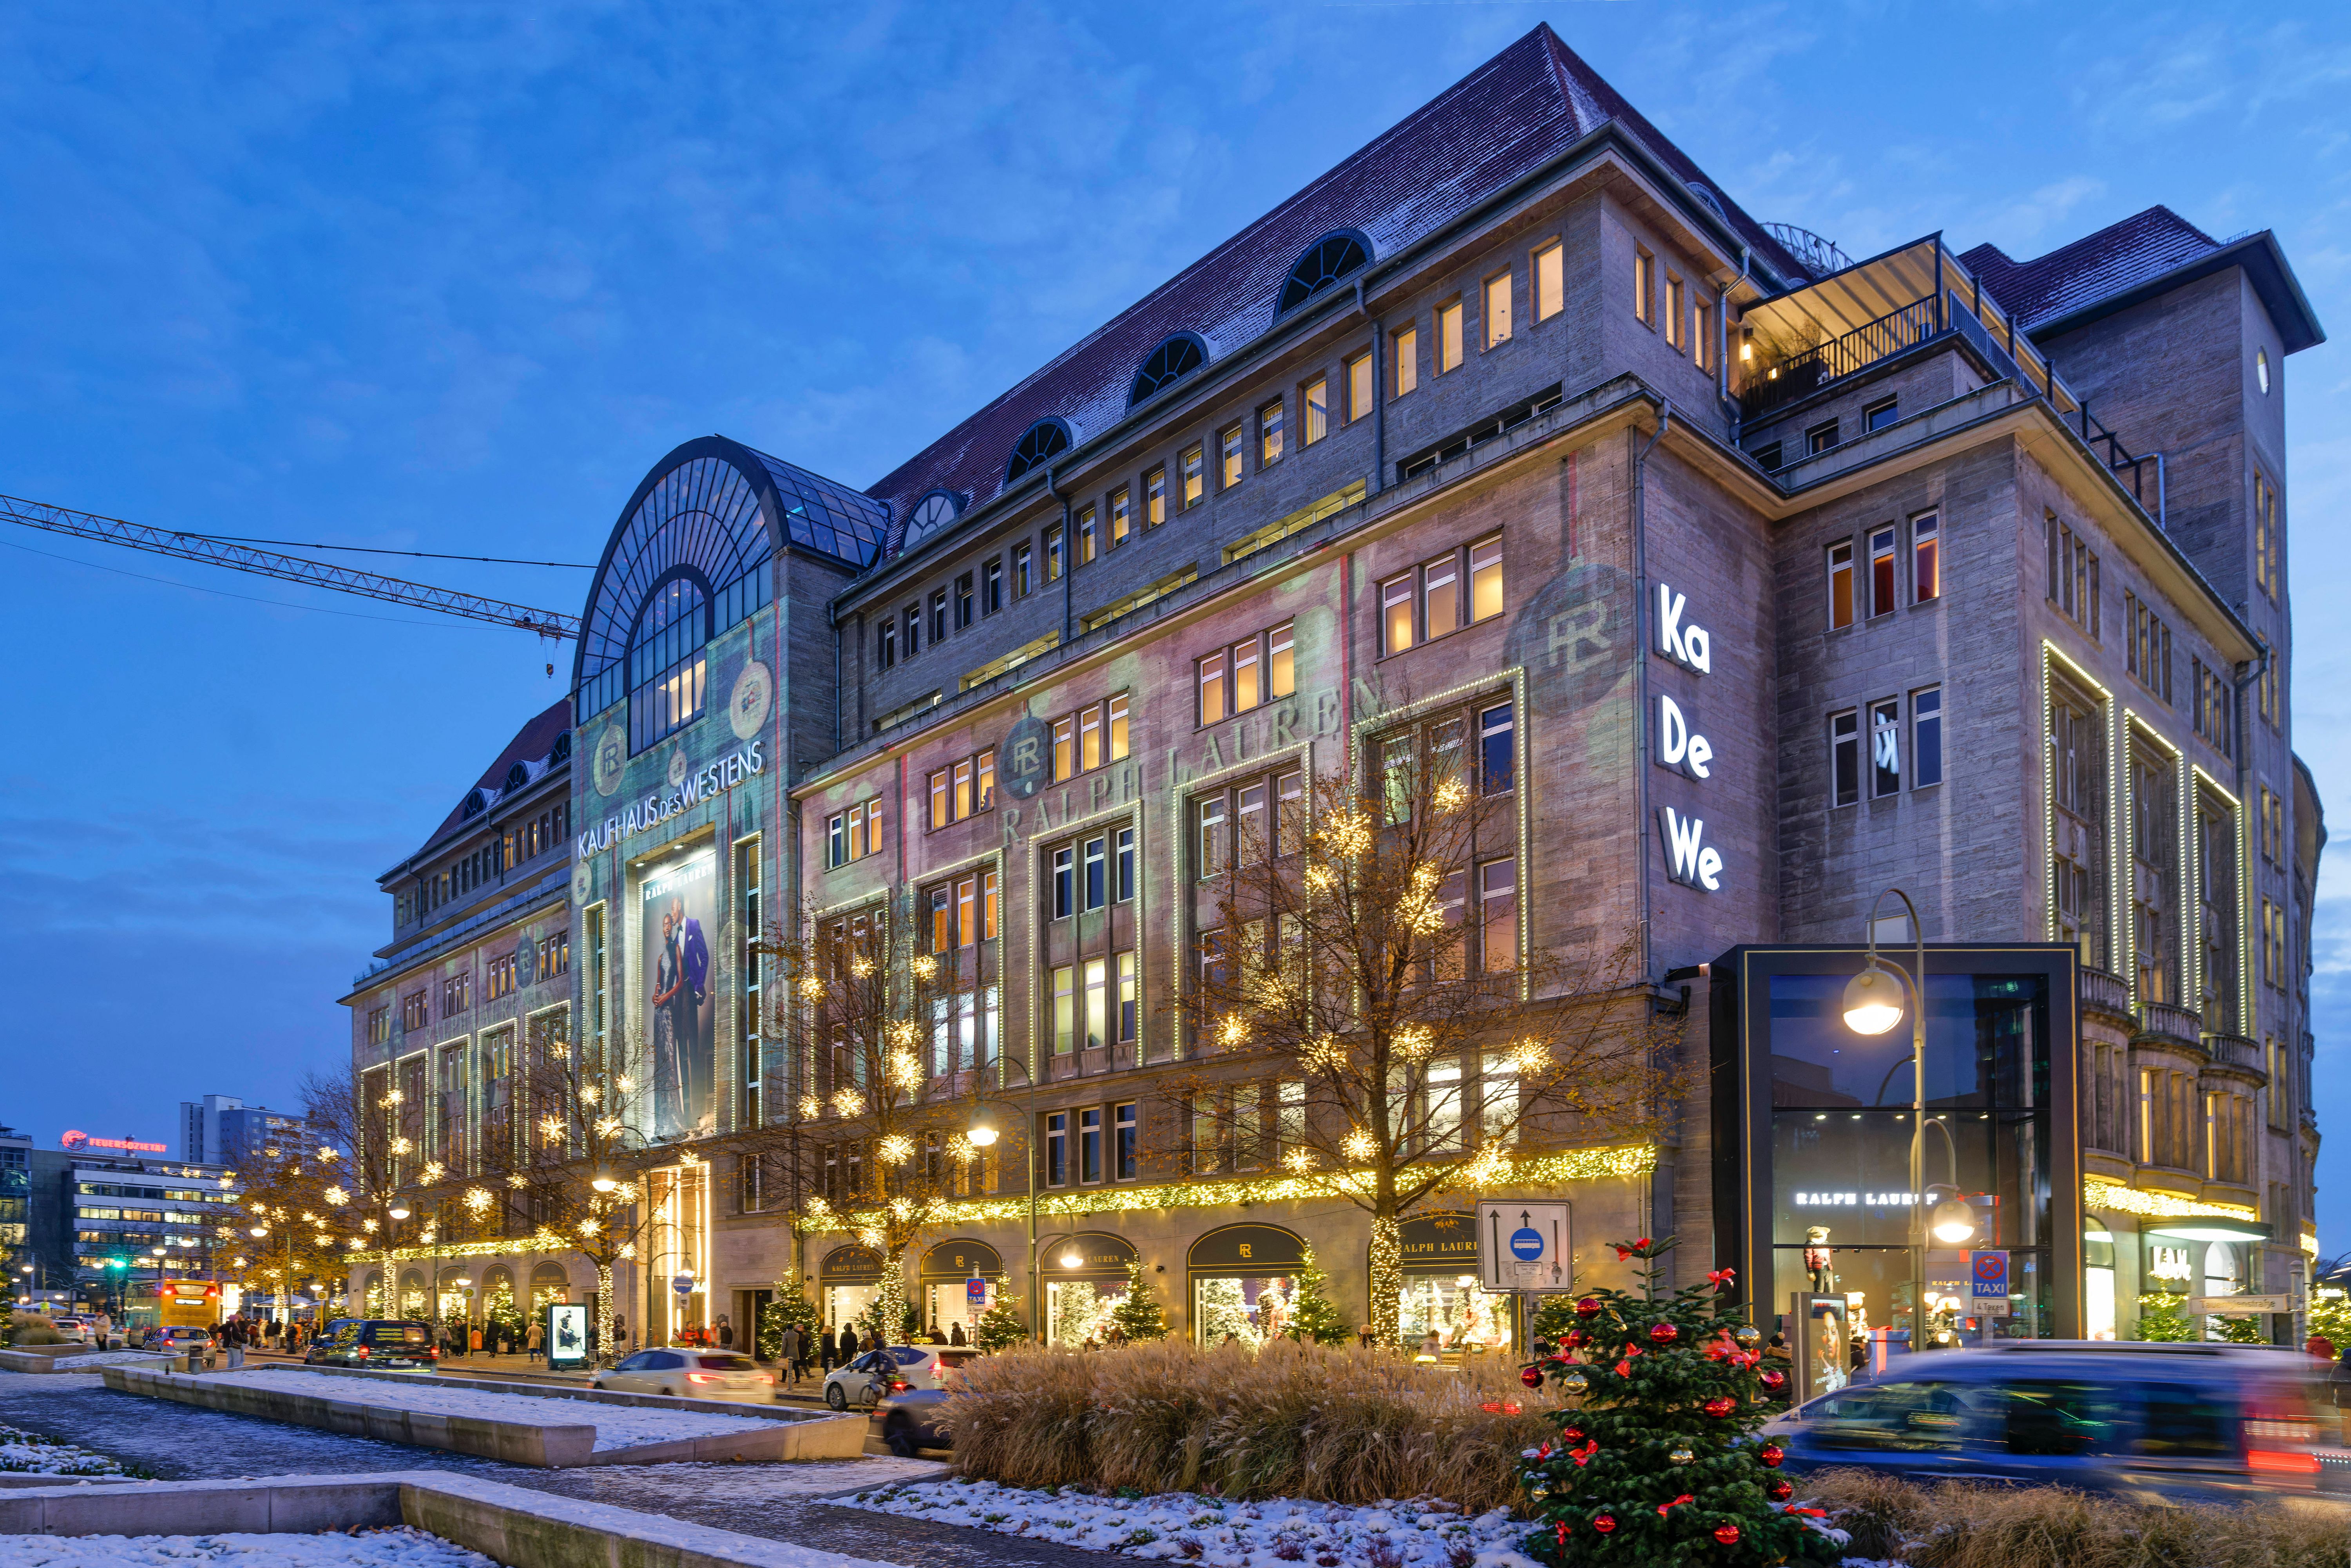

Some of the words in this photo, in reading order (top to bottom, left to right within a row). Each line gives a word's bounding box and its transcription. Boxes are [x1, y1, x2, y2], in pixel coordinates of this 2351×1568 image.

[1661, 583, 1710, 674] Ka
[1662, 695, 1713, 779] De
[578, 796, 659, 860] KAUFHAUS
[660, 793, 681, 819] DES
[680, 741, 764, 807] WESTENS
[1666, 806, 1723, 891] We
[645, 882, 673, 901] RALPH
[89, 1137, 167, 1152] FEUERSOZIETÄT
[1797, 1193, 1857, 1205] RALPH
[1396, 1243, 1434, 1253] RALPH
[1088, 1255, 1119, 1263] LAUREN
[1975, 1283, 2005, 1293] TAXI
